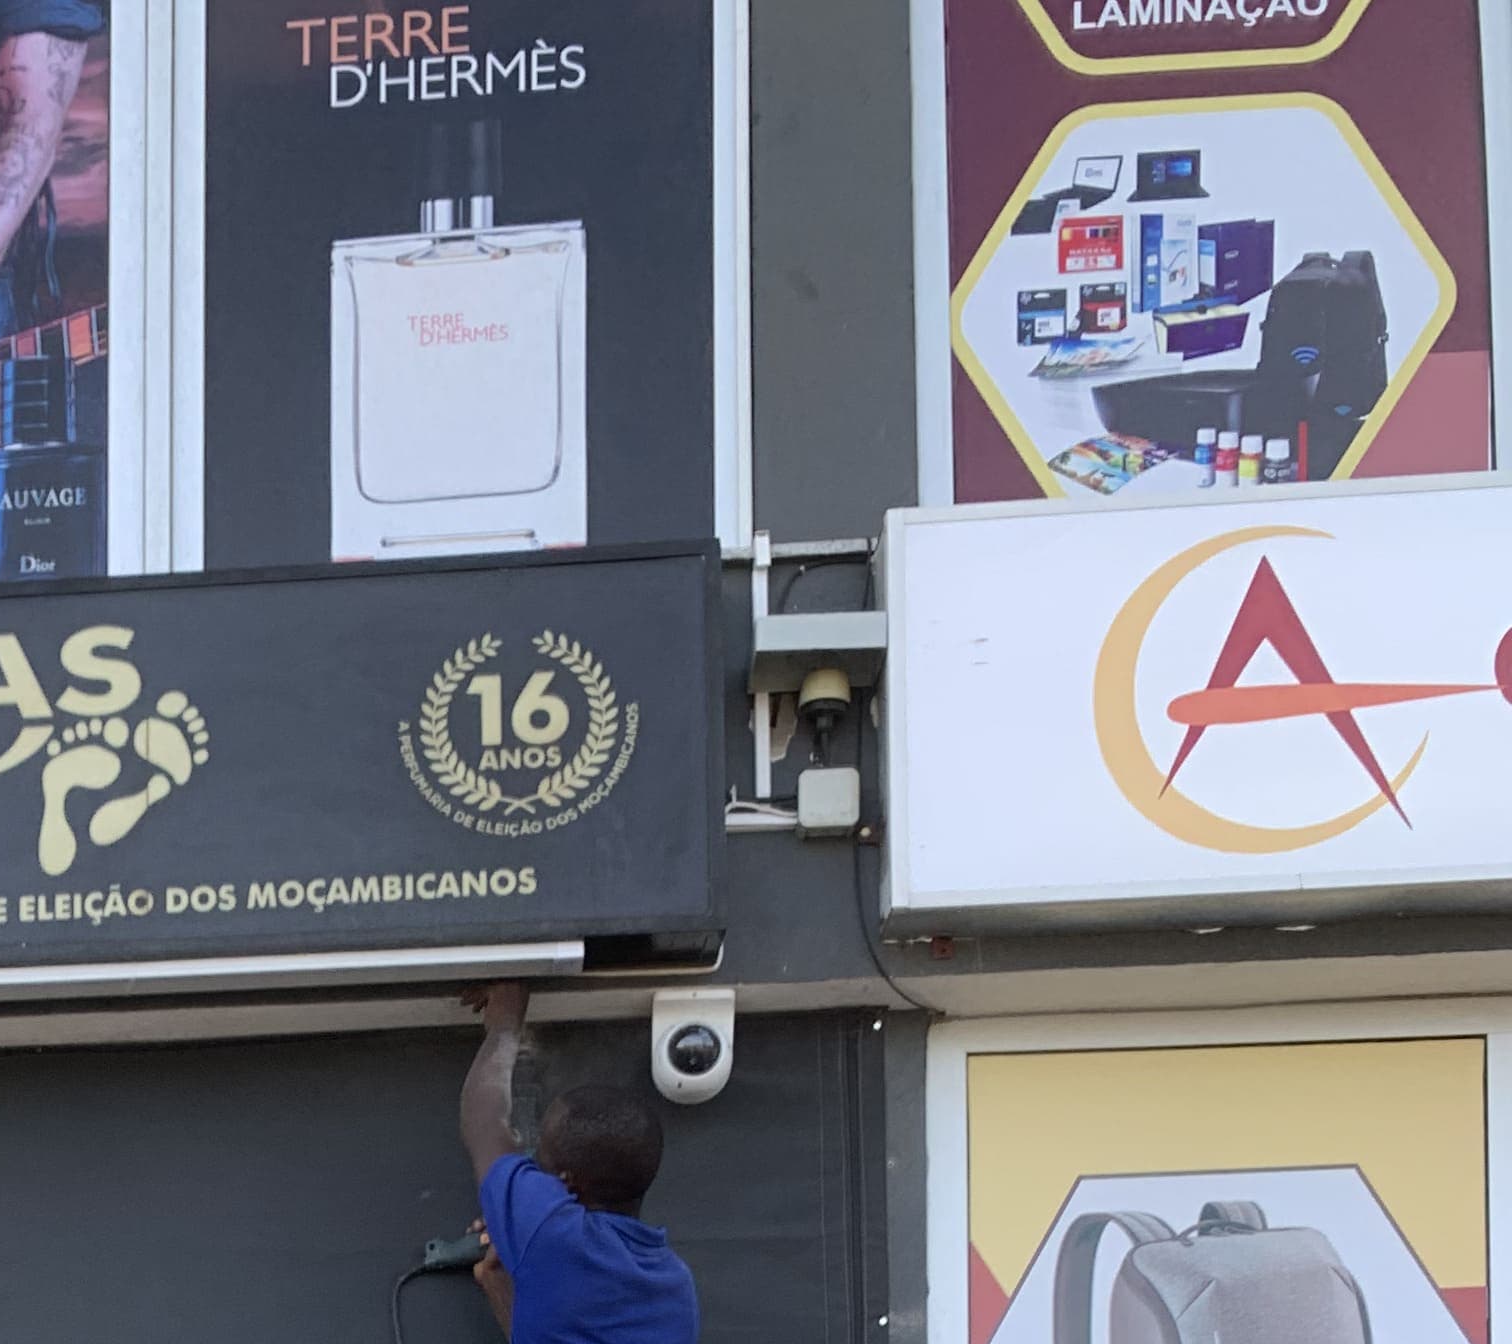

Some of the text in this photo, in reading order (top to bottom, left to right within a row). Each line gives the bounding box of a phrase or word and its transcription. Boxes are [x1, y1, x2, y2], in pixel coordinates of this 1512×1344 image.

[286, 6, 471, 66] TERRE
[407, 313, 464, 333] TERRE
[19, 553, 57, 574] Dior
[466, 671, 570, 747] 16
[397, 701, 640, 838] A PERFUMARIA DE ELEIÇÃO DOS MOÇAMBICANOS
[479, 746, 563, 772] ANOS
[19, 883, 154, 927] ELEIÇÃO
[165, 884, 237, 914] DOS
[246, 866, 538, 914] MOÇAMBICANOS
